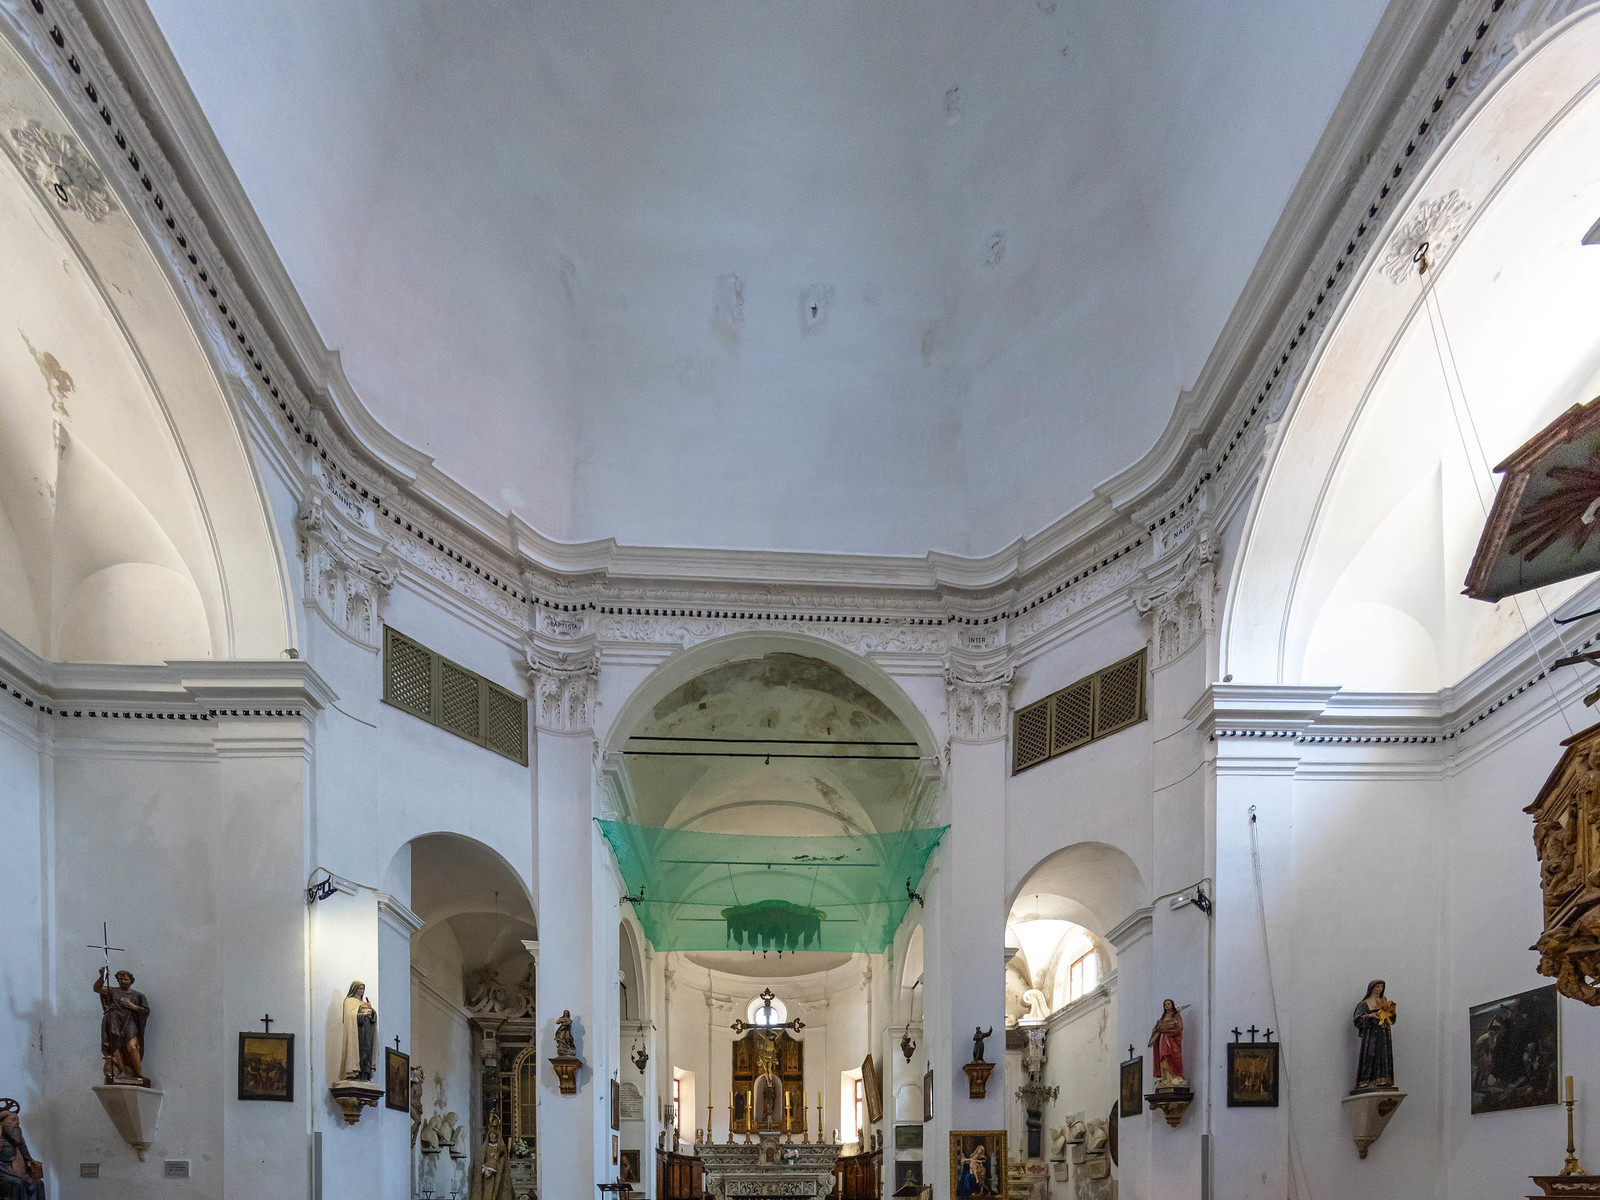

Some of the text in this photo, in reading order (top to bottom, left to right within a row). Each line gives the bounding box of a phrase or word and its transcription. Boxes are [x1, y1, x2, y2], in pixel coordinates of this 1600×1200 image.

[326, 481, 353, 511] JOANNE
[1173, 516, 1195, 539] NATOS
[550, 620, 578, 631] BAPTISTA
